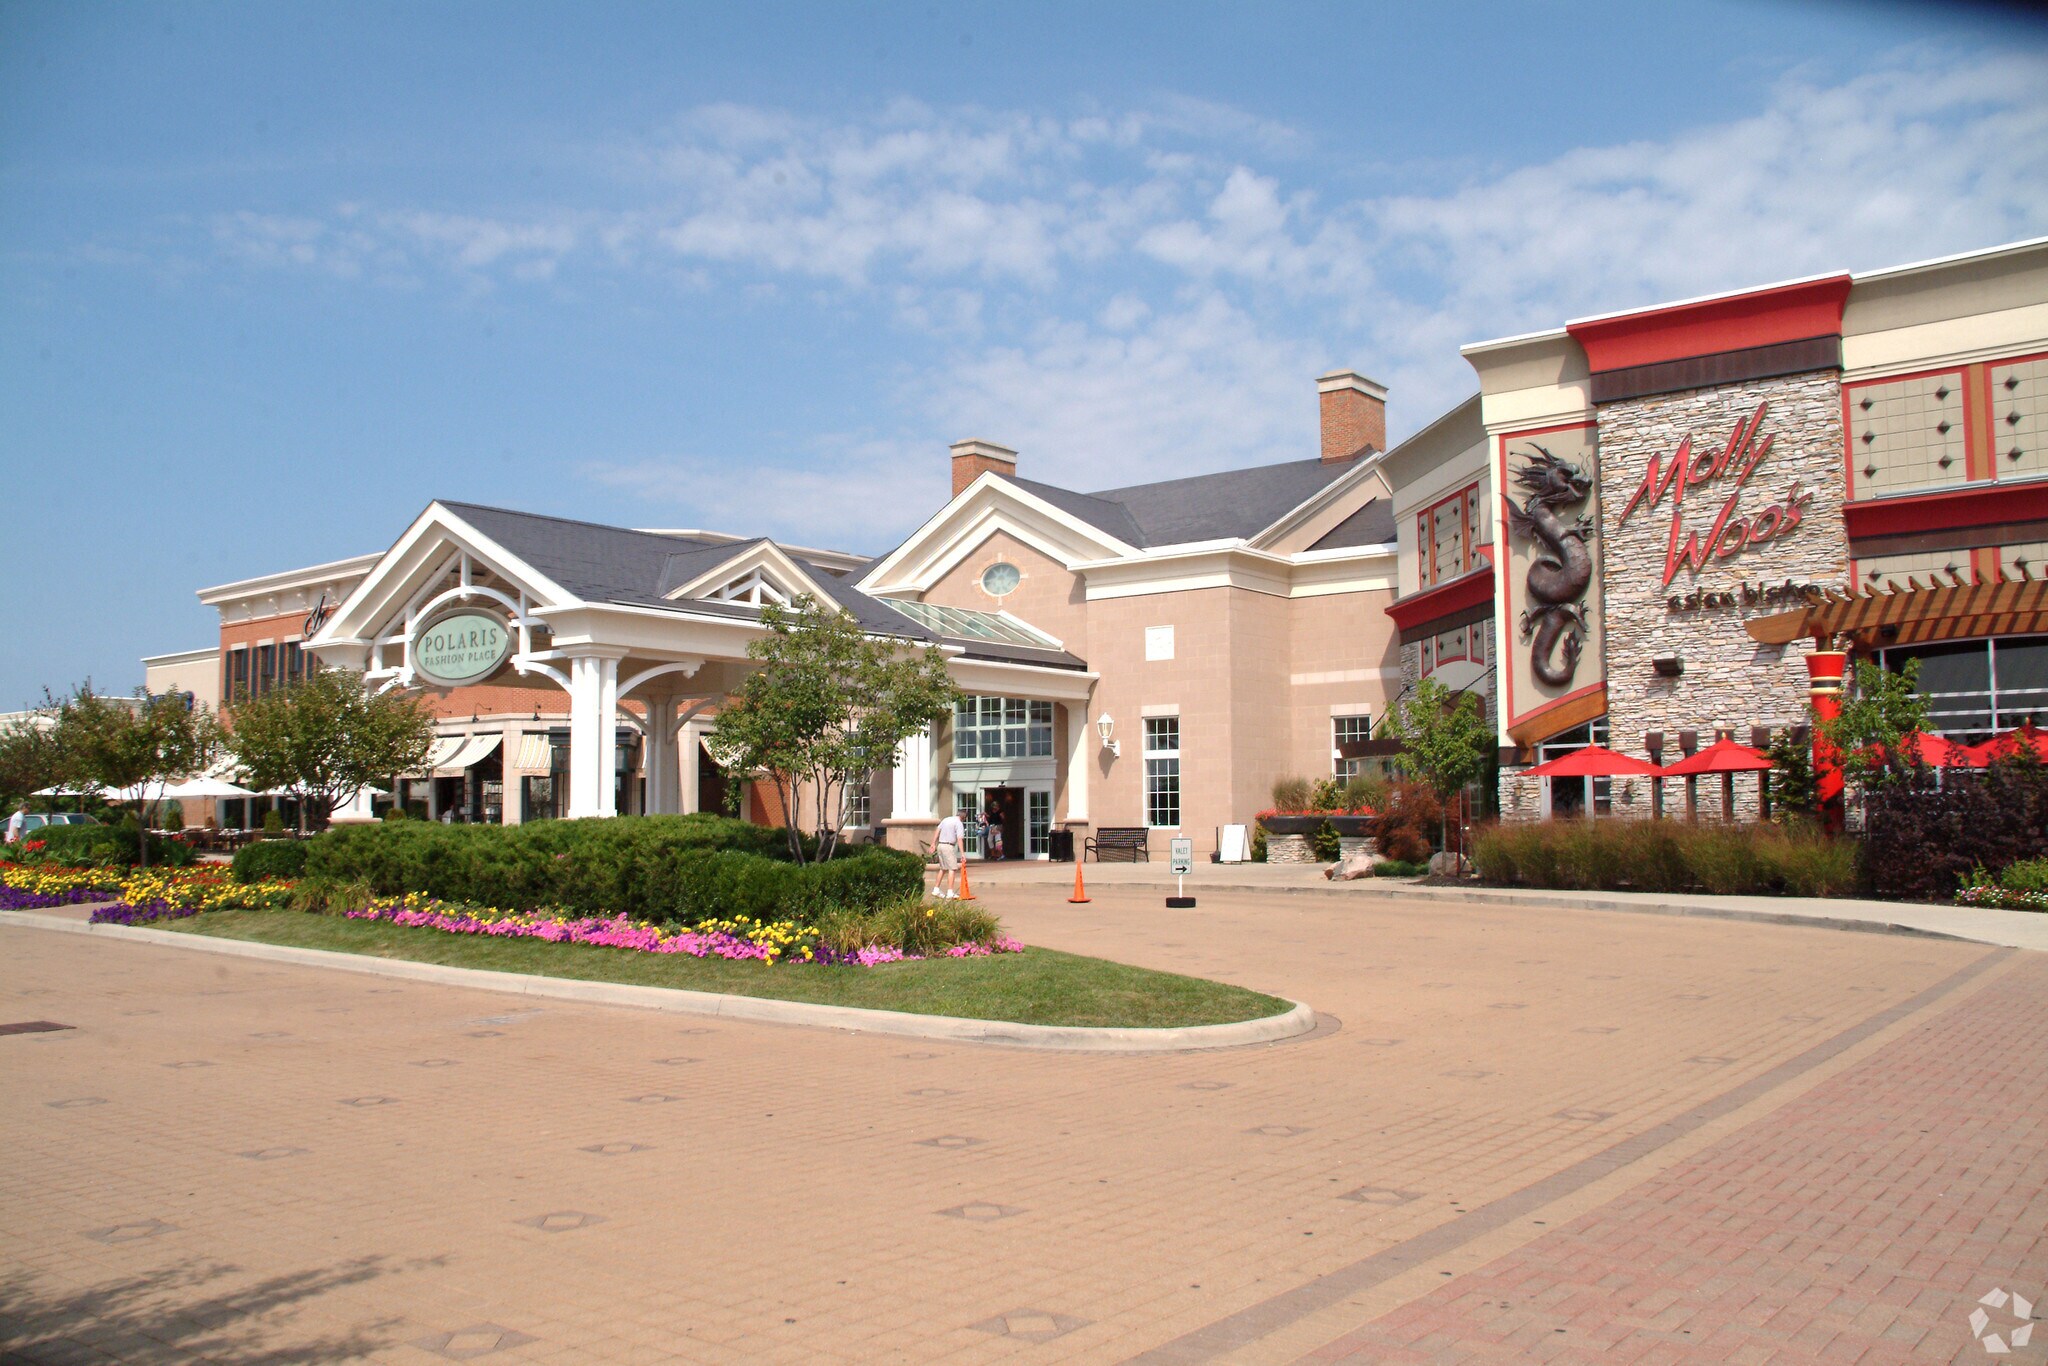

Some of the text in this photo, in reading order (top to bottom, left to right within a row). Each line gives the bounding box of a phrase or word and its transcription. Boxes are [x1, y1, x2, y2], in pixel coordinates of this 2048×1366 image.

[1618, 400, 1776, 527] Molly
[1662, 481, 1814, 586] Woo's
[1667, 578, 1821, 609] asian bistro
[425, 628, 497, 653] POLARIS
[424, 649, 496, 667] FASHION PLACE
[1172, 858, 1190, 866] PARKING
